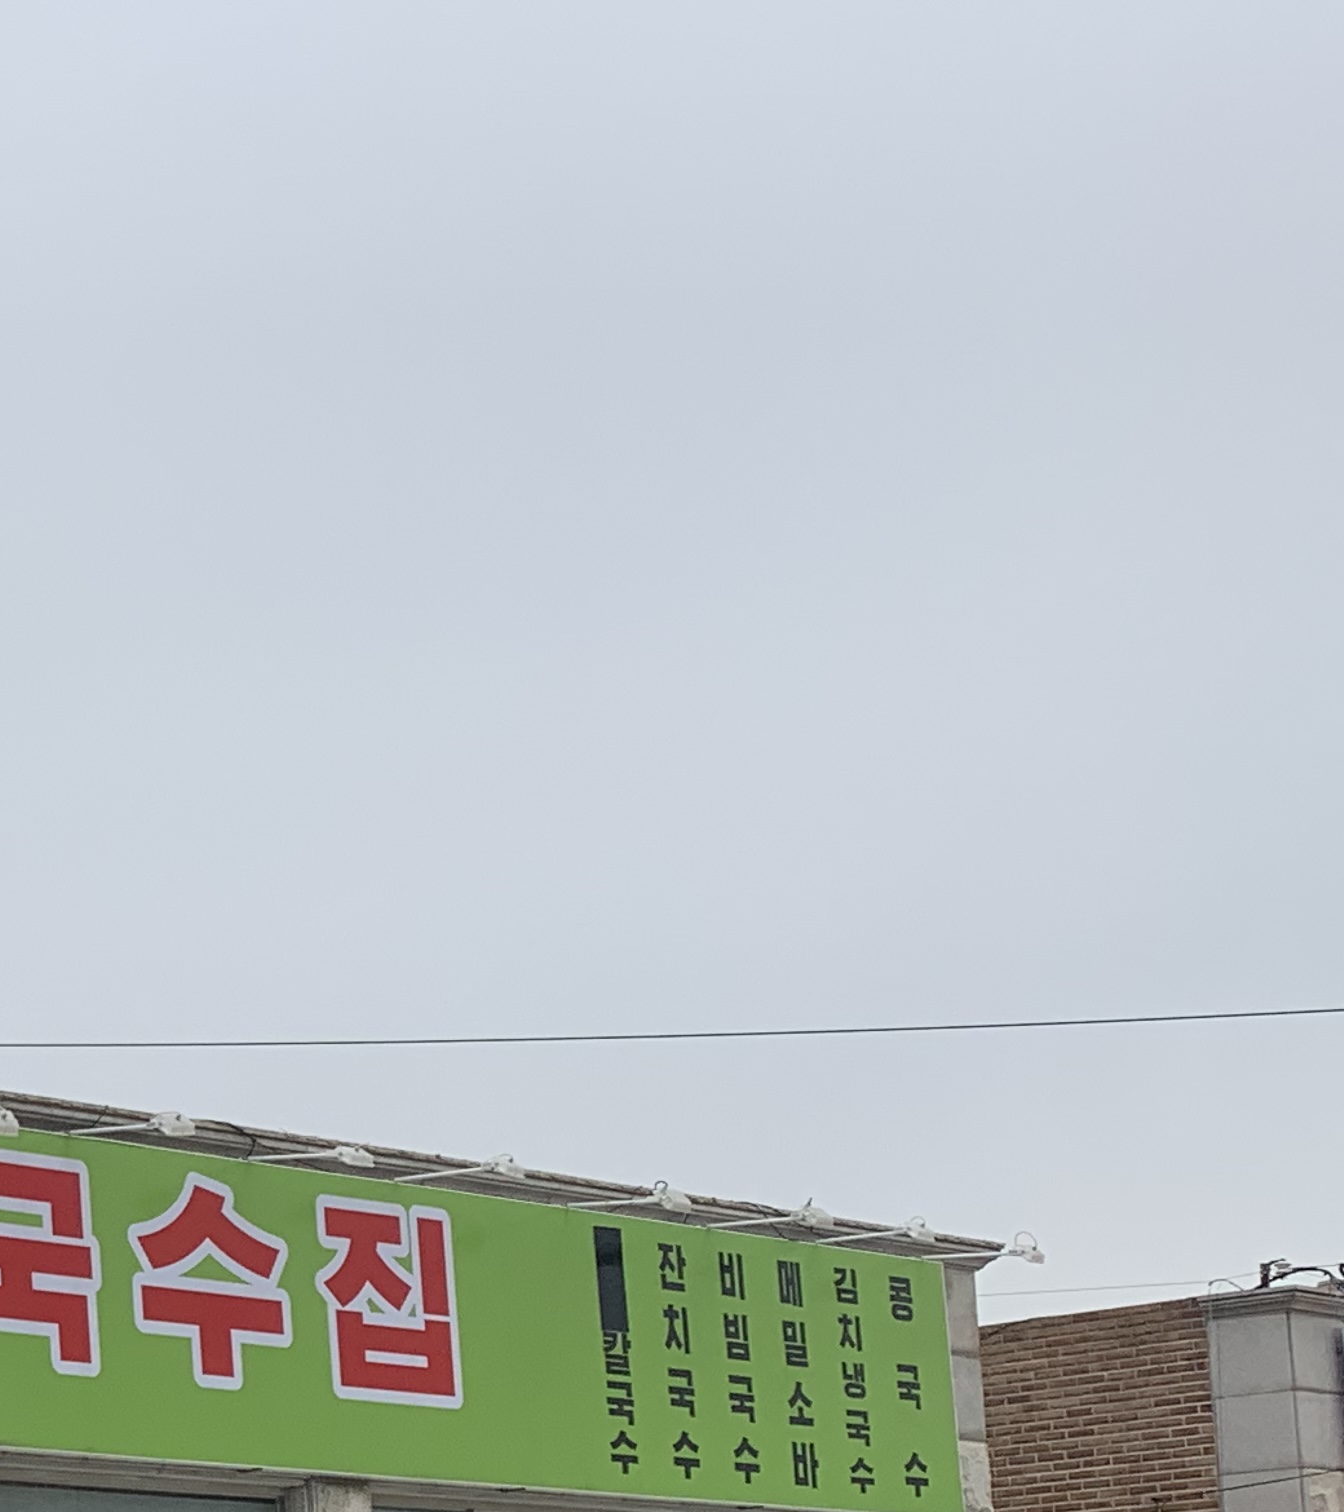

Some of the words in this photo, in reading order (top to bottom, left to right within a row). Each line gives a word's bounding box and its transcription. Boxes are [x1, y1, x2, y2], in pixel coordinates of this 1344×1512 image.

[602, 1330, 639, 1475] 칼국수
[657, 1242, 700, 1480] 잔치국수
[718, 1251, 761, 1484] 비빔국수
[776, 1260, 820, 1490] 메밀소바
[833, 1267, 875, 1494] 김치냉국수
[889, 1276, 930, 1498] 콩국수
